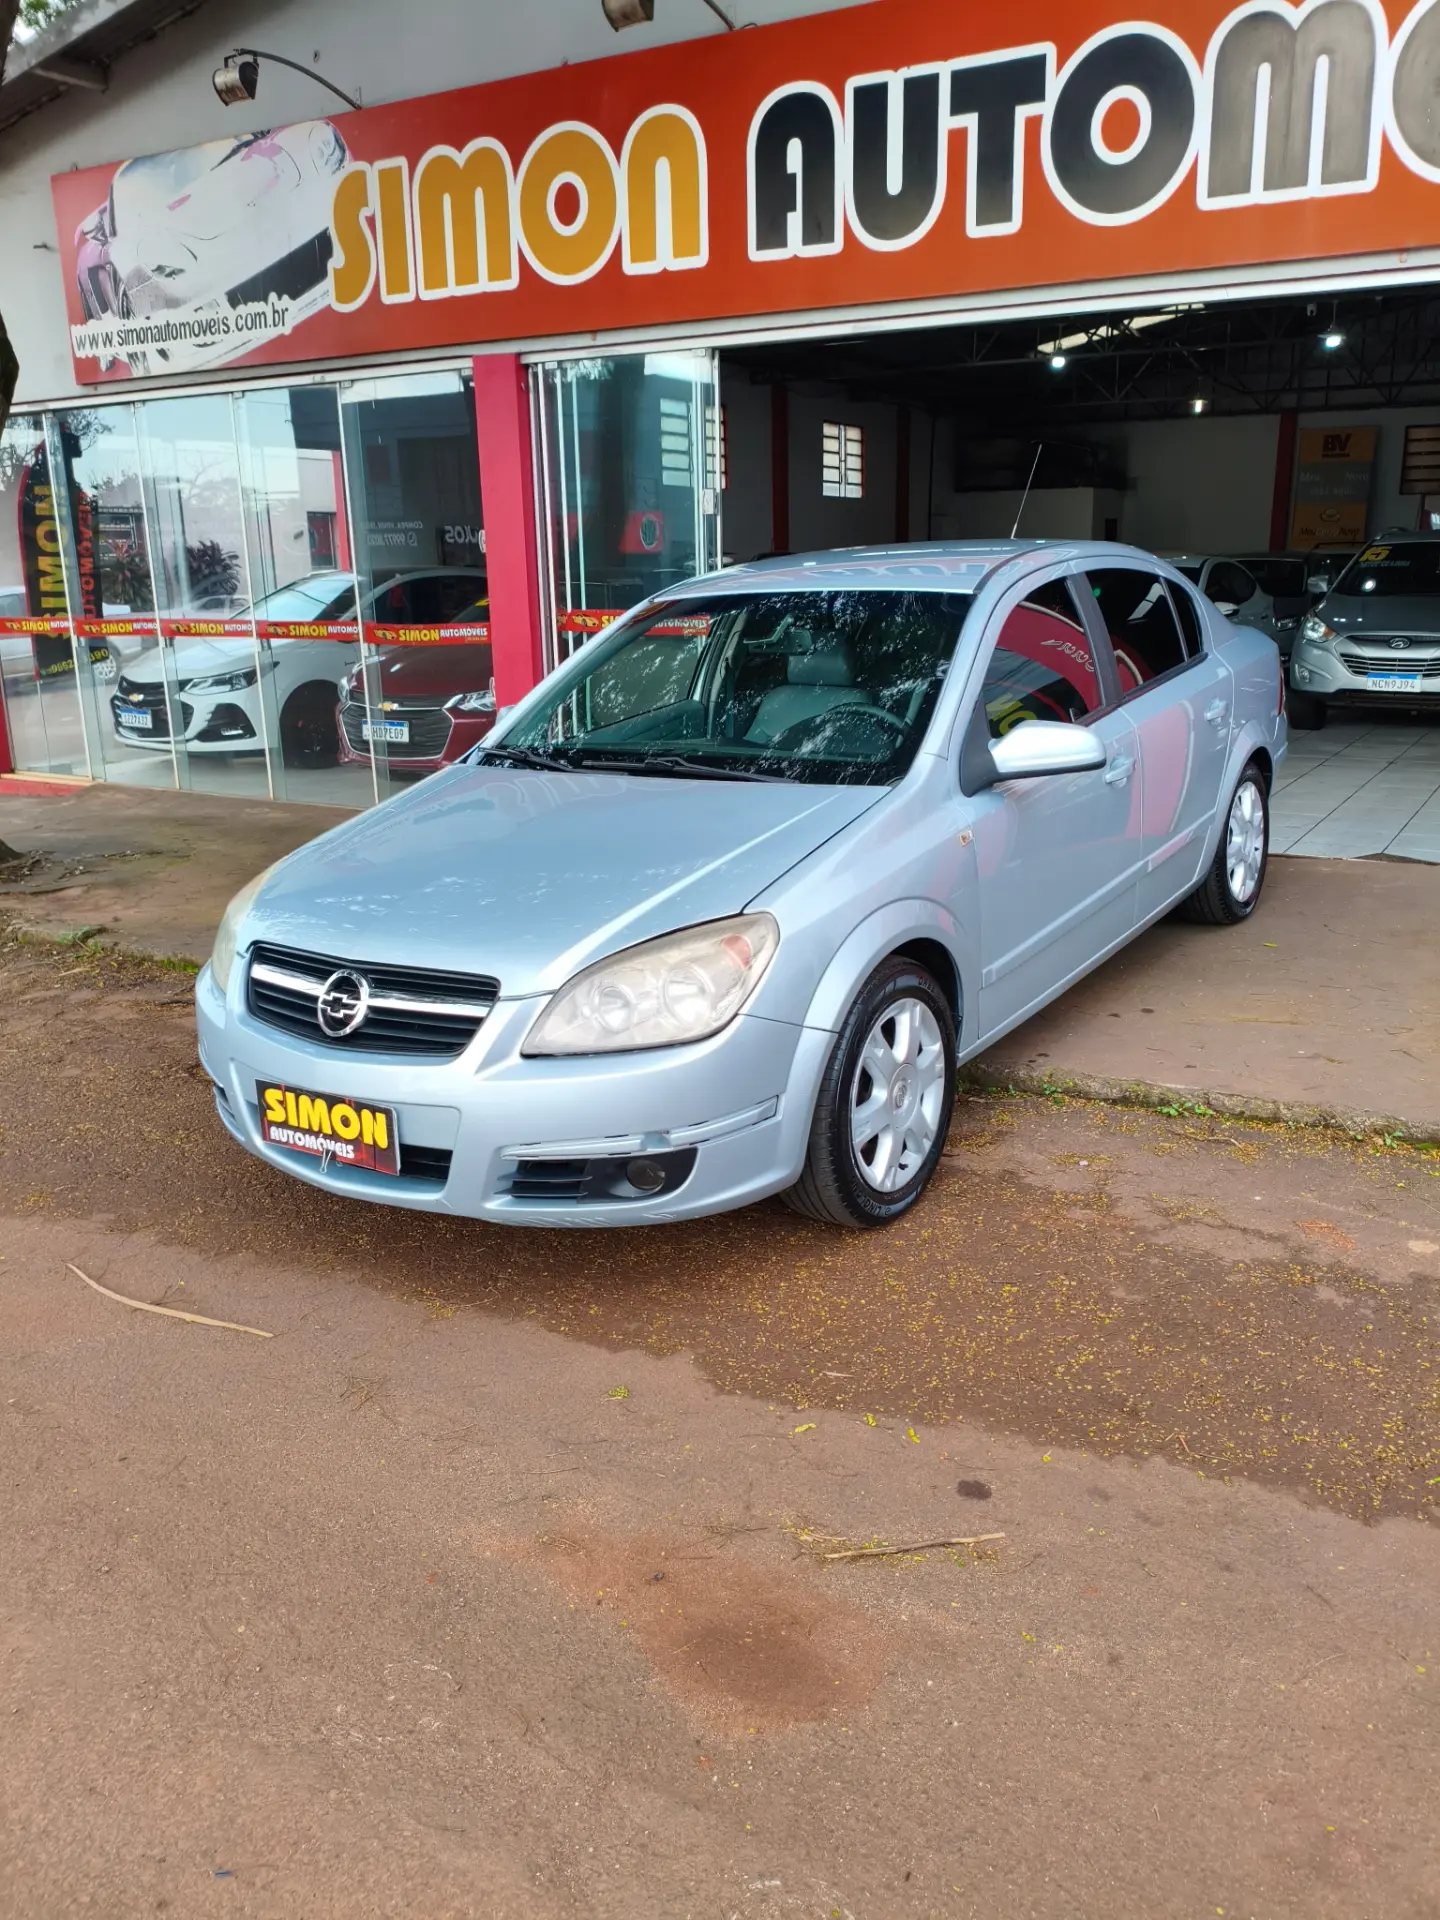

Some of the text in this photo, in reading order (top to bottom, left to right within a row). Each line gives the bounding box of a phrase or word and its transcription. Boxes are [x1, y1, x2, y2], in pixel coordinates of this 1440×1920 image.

[329, 103, 709, 313] SIMON
[75, 301, 289, 351] www.simonautomoveis.com.br
[1323, 432, 1353, 452] BV
[101, 622, 133, 634] SIMON
[190, 623, 224, 635] SIMON
[289, 625, 327, 637] SIMON
[399, 629, 439, 641] SIMON
[263, 1087, 389, 1150] SIMON
[269, 1126, 355, 1159] AUTOMÓVEIS
